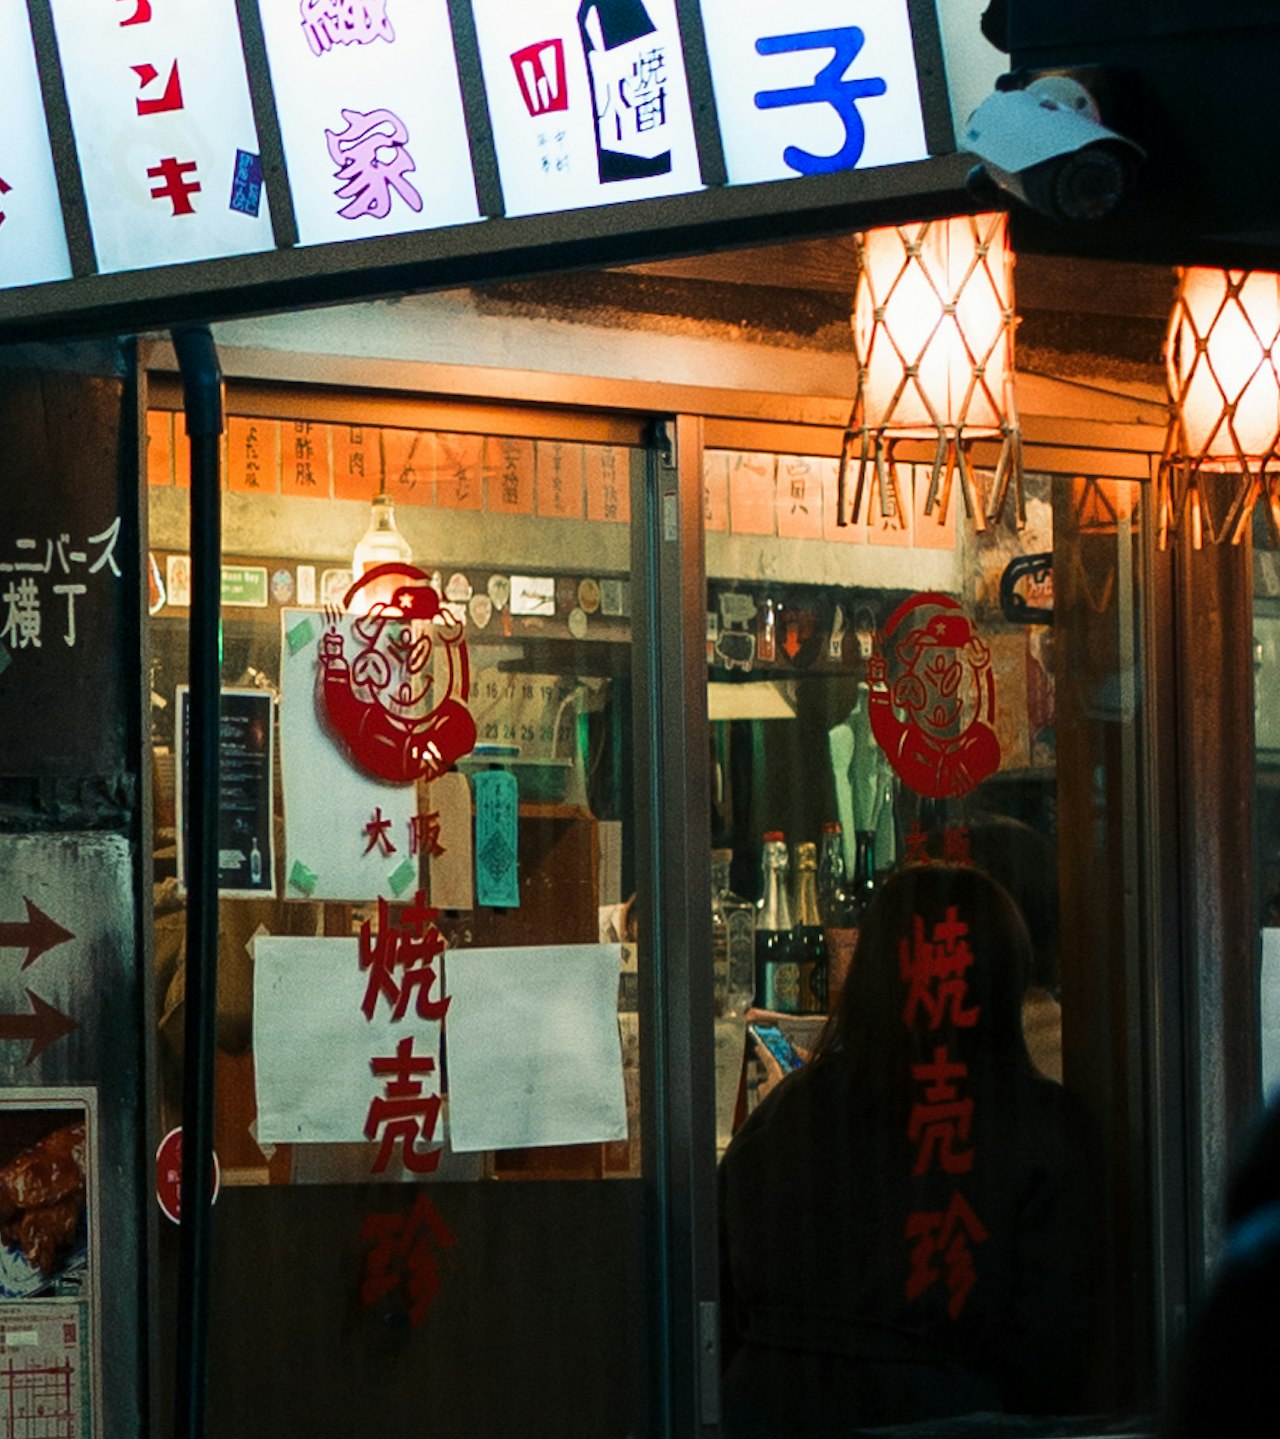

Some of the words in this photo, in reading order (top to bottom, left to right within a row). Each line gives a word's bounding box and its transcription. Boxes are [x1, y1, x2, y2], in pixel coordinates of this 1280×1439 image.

[0, 581, 88, 649] 横丁
[361, 808, 446, 857] 大阪
[358, 889, 457, 1328] 焼売珍
[899, 905, 992, 1320] 焼売珍
